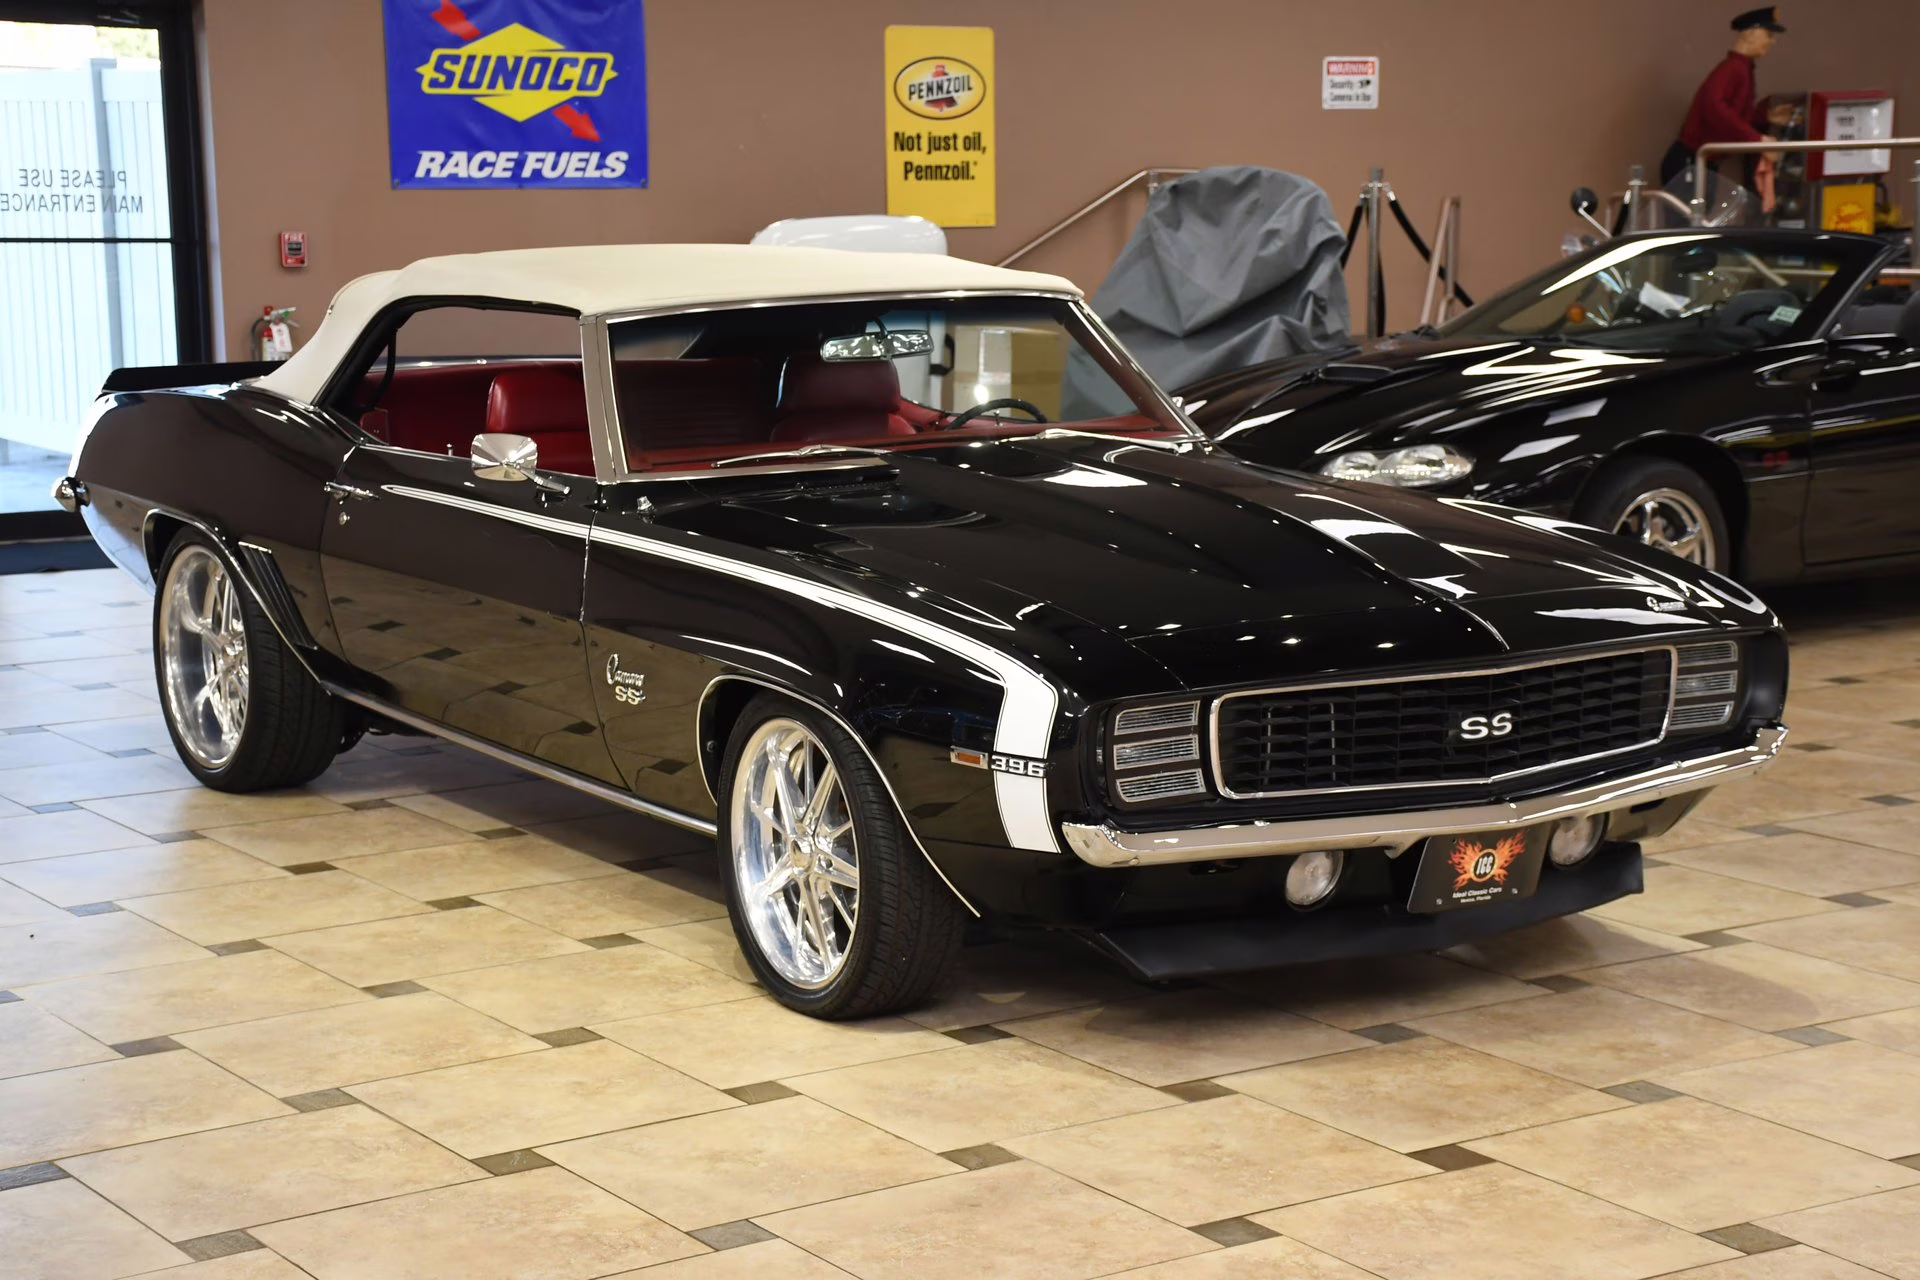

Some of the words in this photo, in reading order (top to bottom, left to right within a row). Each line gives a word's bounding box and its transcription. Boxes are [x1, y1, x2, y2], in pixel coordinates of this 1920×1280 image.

[428, 54, 608, 91] SUNOCO
[908, 75, 973, 101] PENNZOIL
[894, 132, 922, 152] Not
[926, 132, 958, 155] just
[963, 132, 987, 154] oil,
[414, 150, 519, 179] RACE
[520, 150, 629, 179] FUELS
[615, 685, 646, 705] SS
[1460, 712, 1512, 739] SS
[991, 755, 1047, 777] 396
[1467, 889, 1488, 897] Classic
